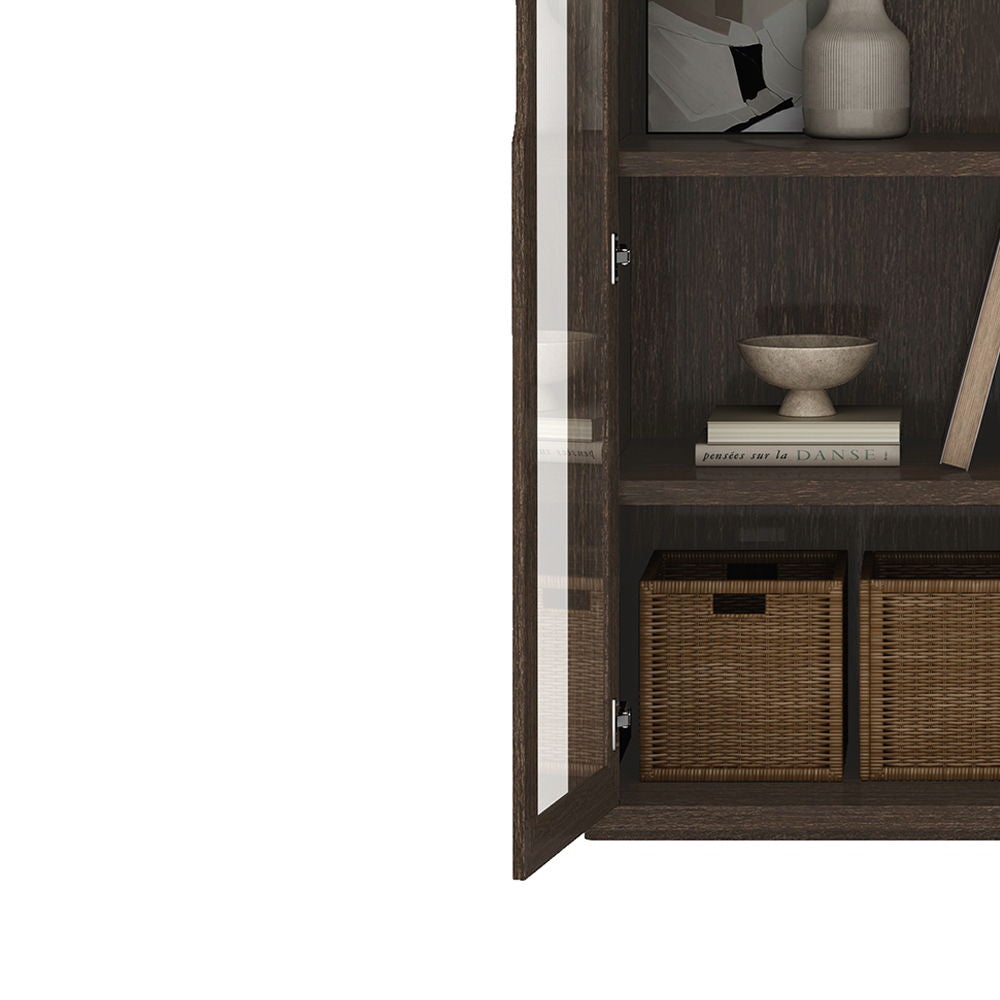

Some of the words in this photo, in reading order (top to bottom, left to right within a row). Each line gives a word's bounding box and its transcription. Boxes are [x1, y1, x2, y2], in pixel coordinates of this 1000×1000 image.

[750, 451, 770, 460] sur
[775, 450, 788, 460] la
[797, 449, 876, 461] DANSE
